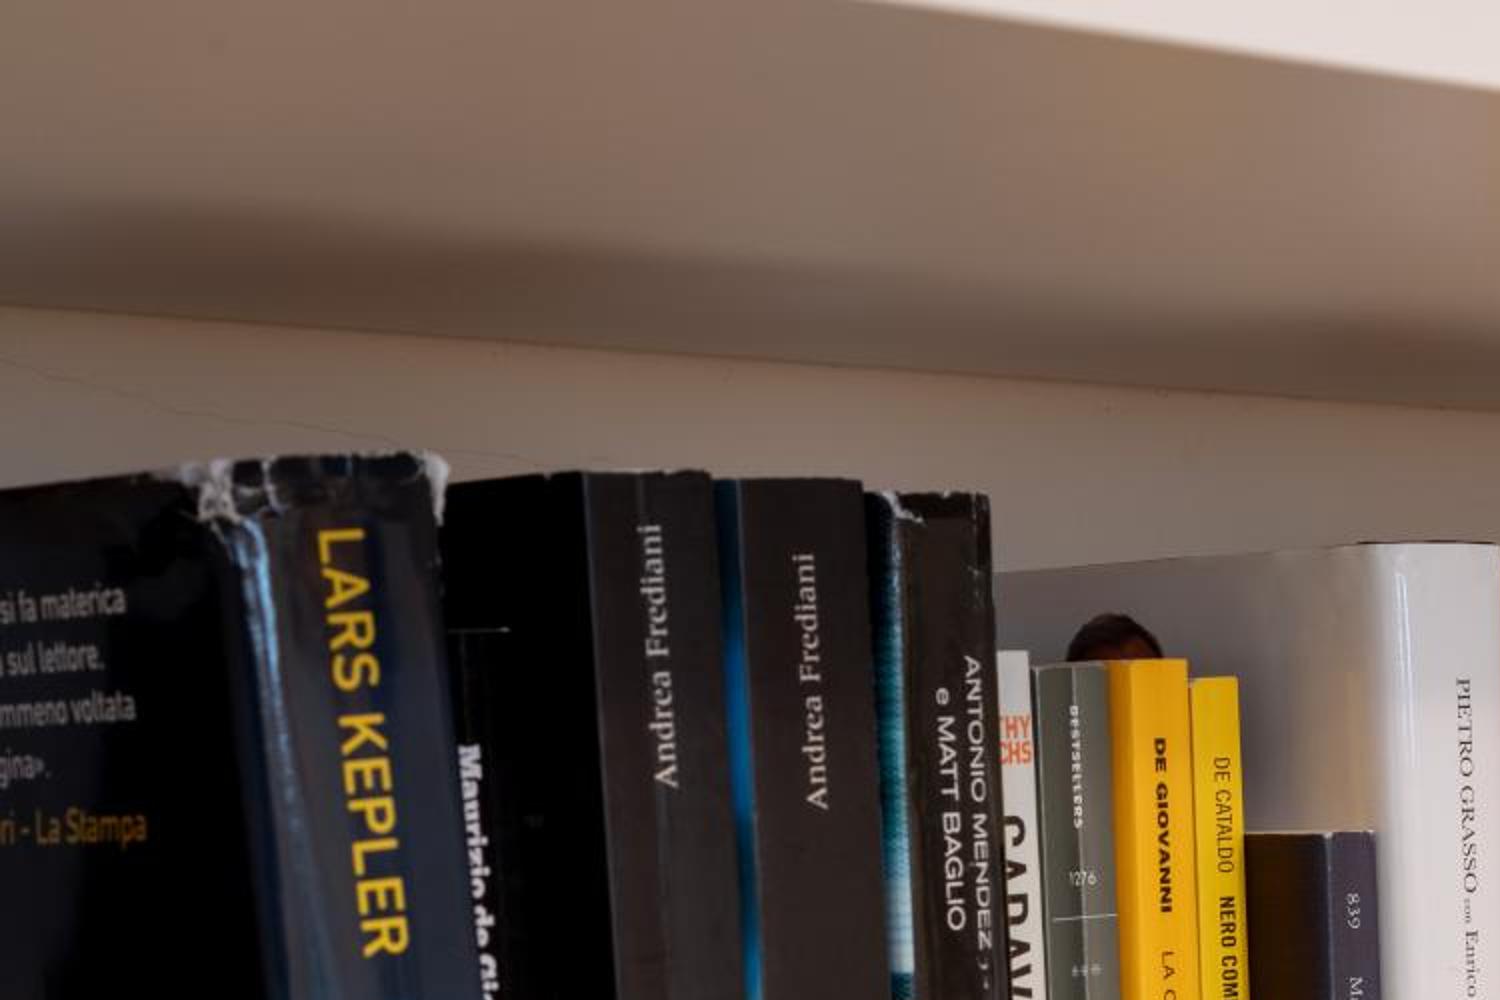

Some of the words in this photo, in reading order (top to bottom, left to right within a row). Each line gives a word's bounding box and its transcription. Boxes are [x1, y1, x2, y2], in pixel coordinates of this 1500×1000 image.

[40, 578, 126, 620] materica
[318, 529, 381, 693] LARS
[637, 523, 671, 658] Frediani
[792, 552, 822, 682] Frediani
[7, 640, 36, 676] sul
[37, 639, 105, 674] lettore.
[935, 687, 950, 706] e
[69, 688, 136, 723] voltata
[649, 670, 680, 789] Andrea
[963, 654, 988, 804] ANTONIO
[1455, 677, 1476, 778] PIETRO
[801, 695, 829, 811] Andrea
[935, 714, 959, 801] MATT
[1068, 703, 1085, 830] BESTSELLERS
[1154, 737, 1168, 772] DE
[1213, 757, 1232, 783] DE
[36, 808, 60, 845] La
[66, 805, 148, 852] Stampa
[338, 712, 411, 958] KEPLER
[457, 743, 489, 900] Maurizio
[1154, 781, 1174, 913] GIOVANNI
[1215, 790, 1236, 874] CATALDO
[1459, 783, 1478, 895] GRASSO
[942, 811, 968, 933] BAGLIO
[971, 812, 994, 951] MENDEZ
[1068, 871, 1098, 887] 1276
[1345, 892, 1361, 930] 839
[1160, 950, 1176, 981] LA
[1219, 895, 1238, 949] NERO
[1464, 929, 1482, 999] Enrico
